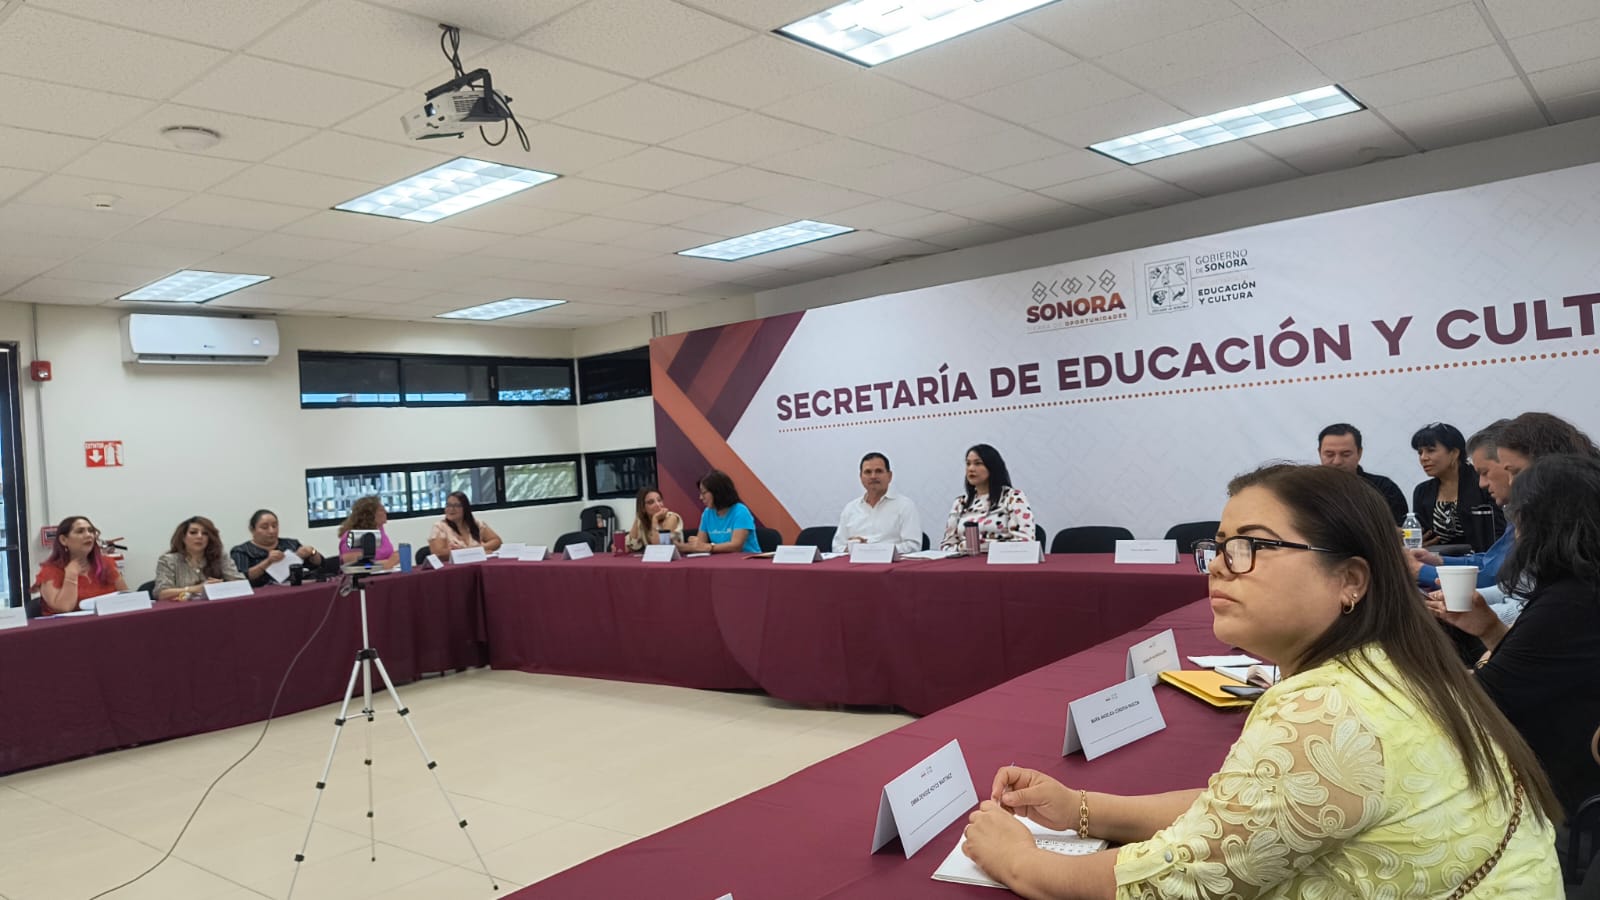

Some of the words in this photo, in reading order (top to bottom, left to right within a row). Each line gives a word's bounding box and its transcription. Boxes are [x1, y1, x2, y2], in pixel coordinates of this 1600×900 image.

[1195, 249, 1248, 265] GOBIERNO
[1204, 258, 1248, 272] SONORA
[1198, 280, 1256, 297] EDUCACIÓN
[1207, 291, 1254, 304] CULTURA
[1026, 292, 1126, 323] SONORA
[776, 362, 978, 421] SECRETARÍA
[989, 362, 1041, 398] DE
[1057, 316, 1352, 391] EDUCACIÓN
[1371, 315, 1413, 356] Y
[1436, 293, 1600, 350] CULT
